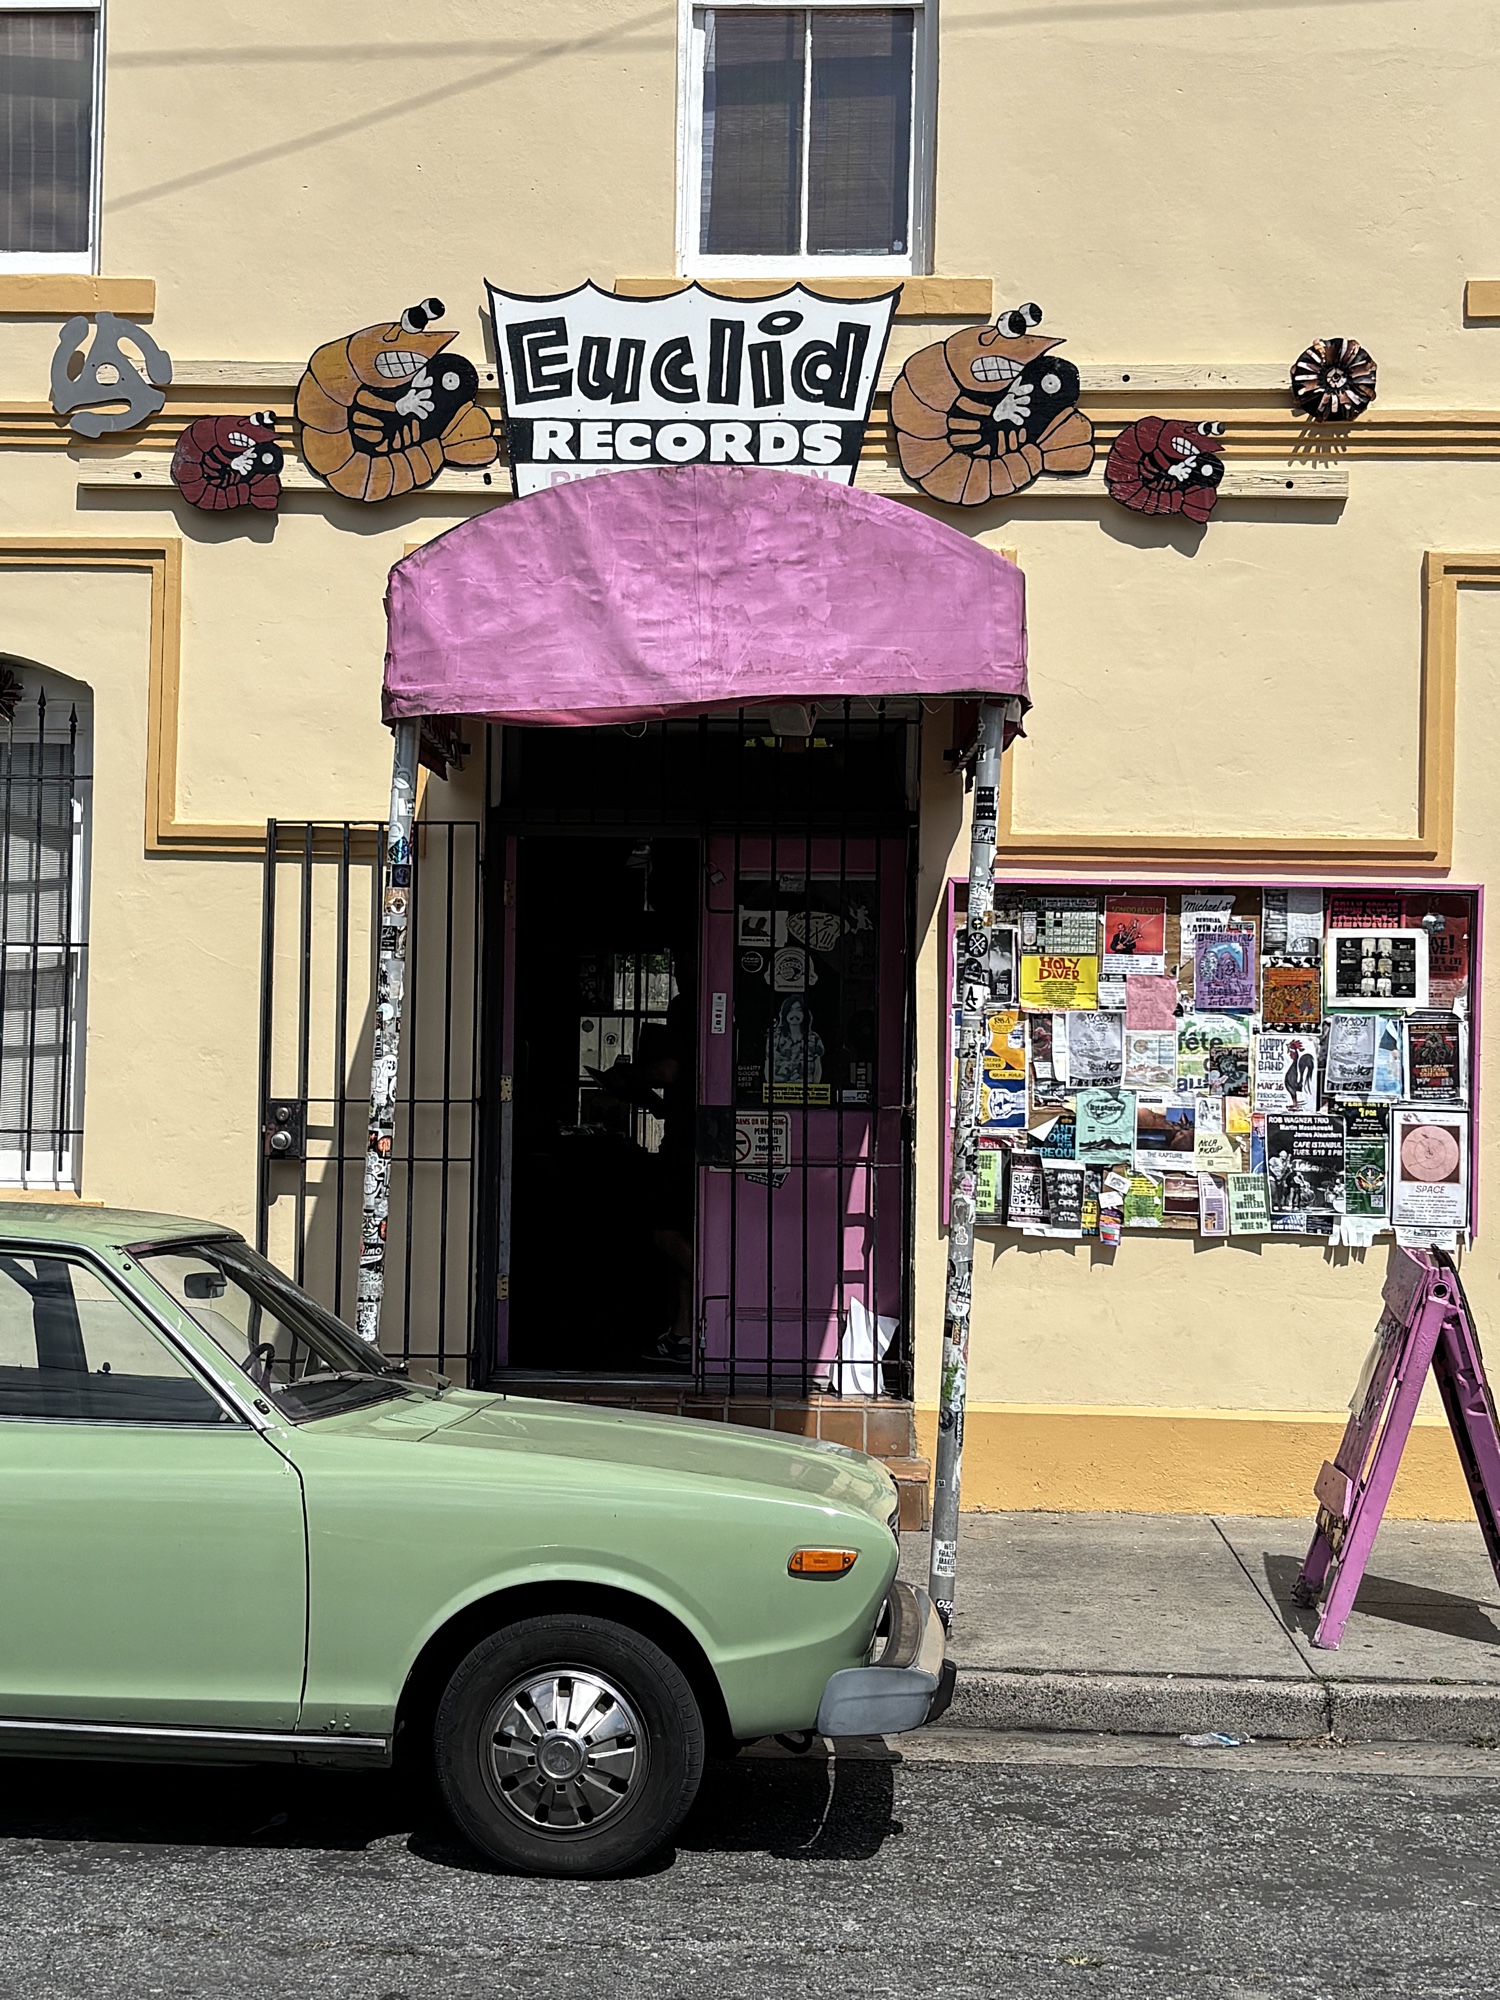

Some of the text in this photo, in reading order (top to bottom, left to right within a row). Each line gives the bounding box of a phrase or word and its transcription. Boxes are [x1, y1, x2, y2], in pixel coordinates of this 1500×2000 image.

[506, 310, 871, 411] Euclid
[532, 420, 843, 464] RECORDS
[1184, 900, 1221, 912] Michael
[1039, 957, 1081, 969] HOLY
[1039, 968, 1080, 980] DIVER
[1178, 1031, 1224, 1052] fête
[1259, 1038, 1286, 1051] HAPPY
[1259, 1051, 1284, 1061] TALK
[1258, 1061, 1284, 1071] BAND
[1053, 1124, 1076, 1134] ANT
[1047, 1134, 1072, 1142] ORE
[1415, 1185, 1446, 1194] SPACE
